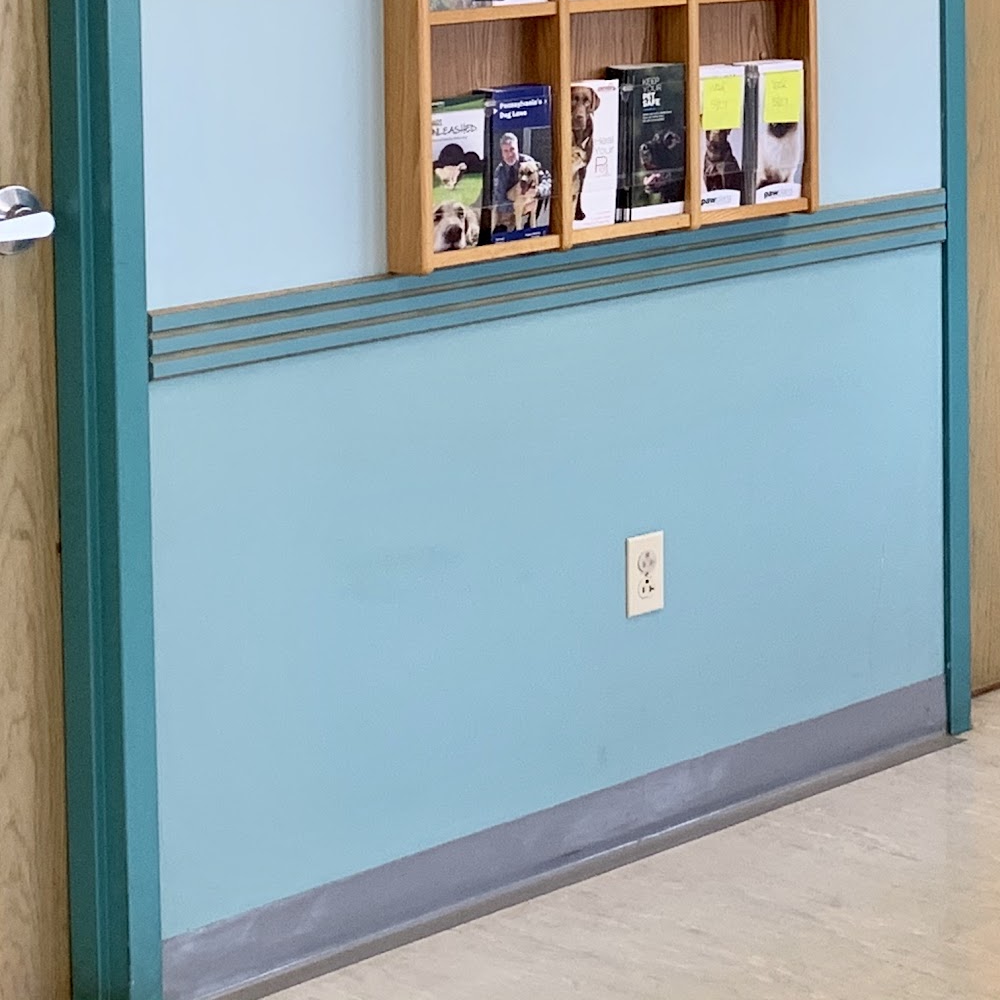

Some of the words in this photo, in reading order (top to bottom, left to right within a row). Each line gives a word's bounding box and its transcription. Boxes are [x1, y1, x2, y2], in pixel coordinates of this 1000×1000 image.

[499, 98, 543, 110] Pennsylvania's
[499, 111, 511, 120] Dog
[512, 110, 528, 118] Laws
